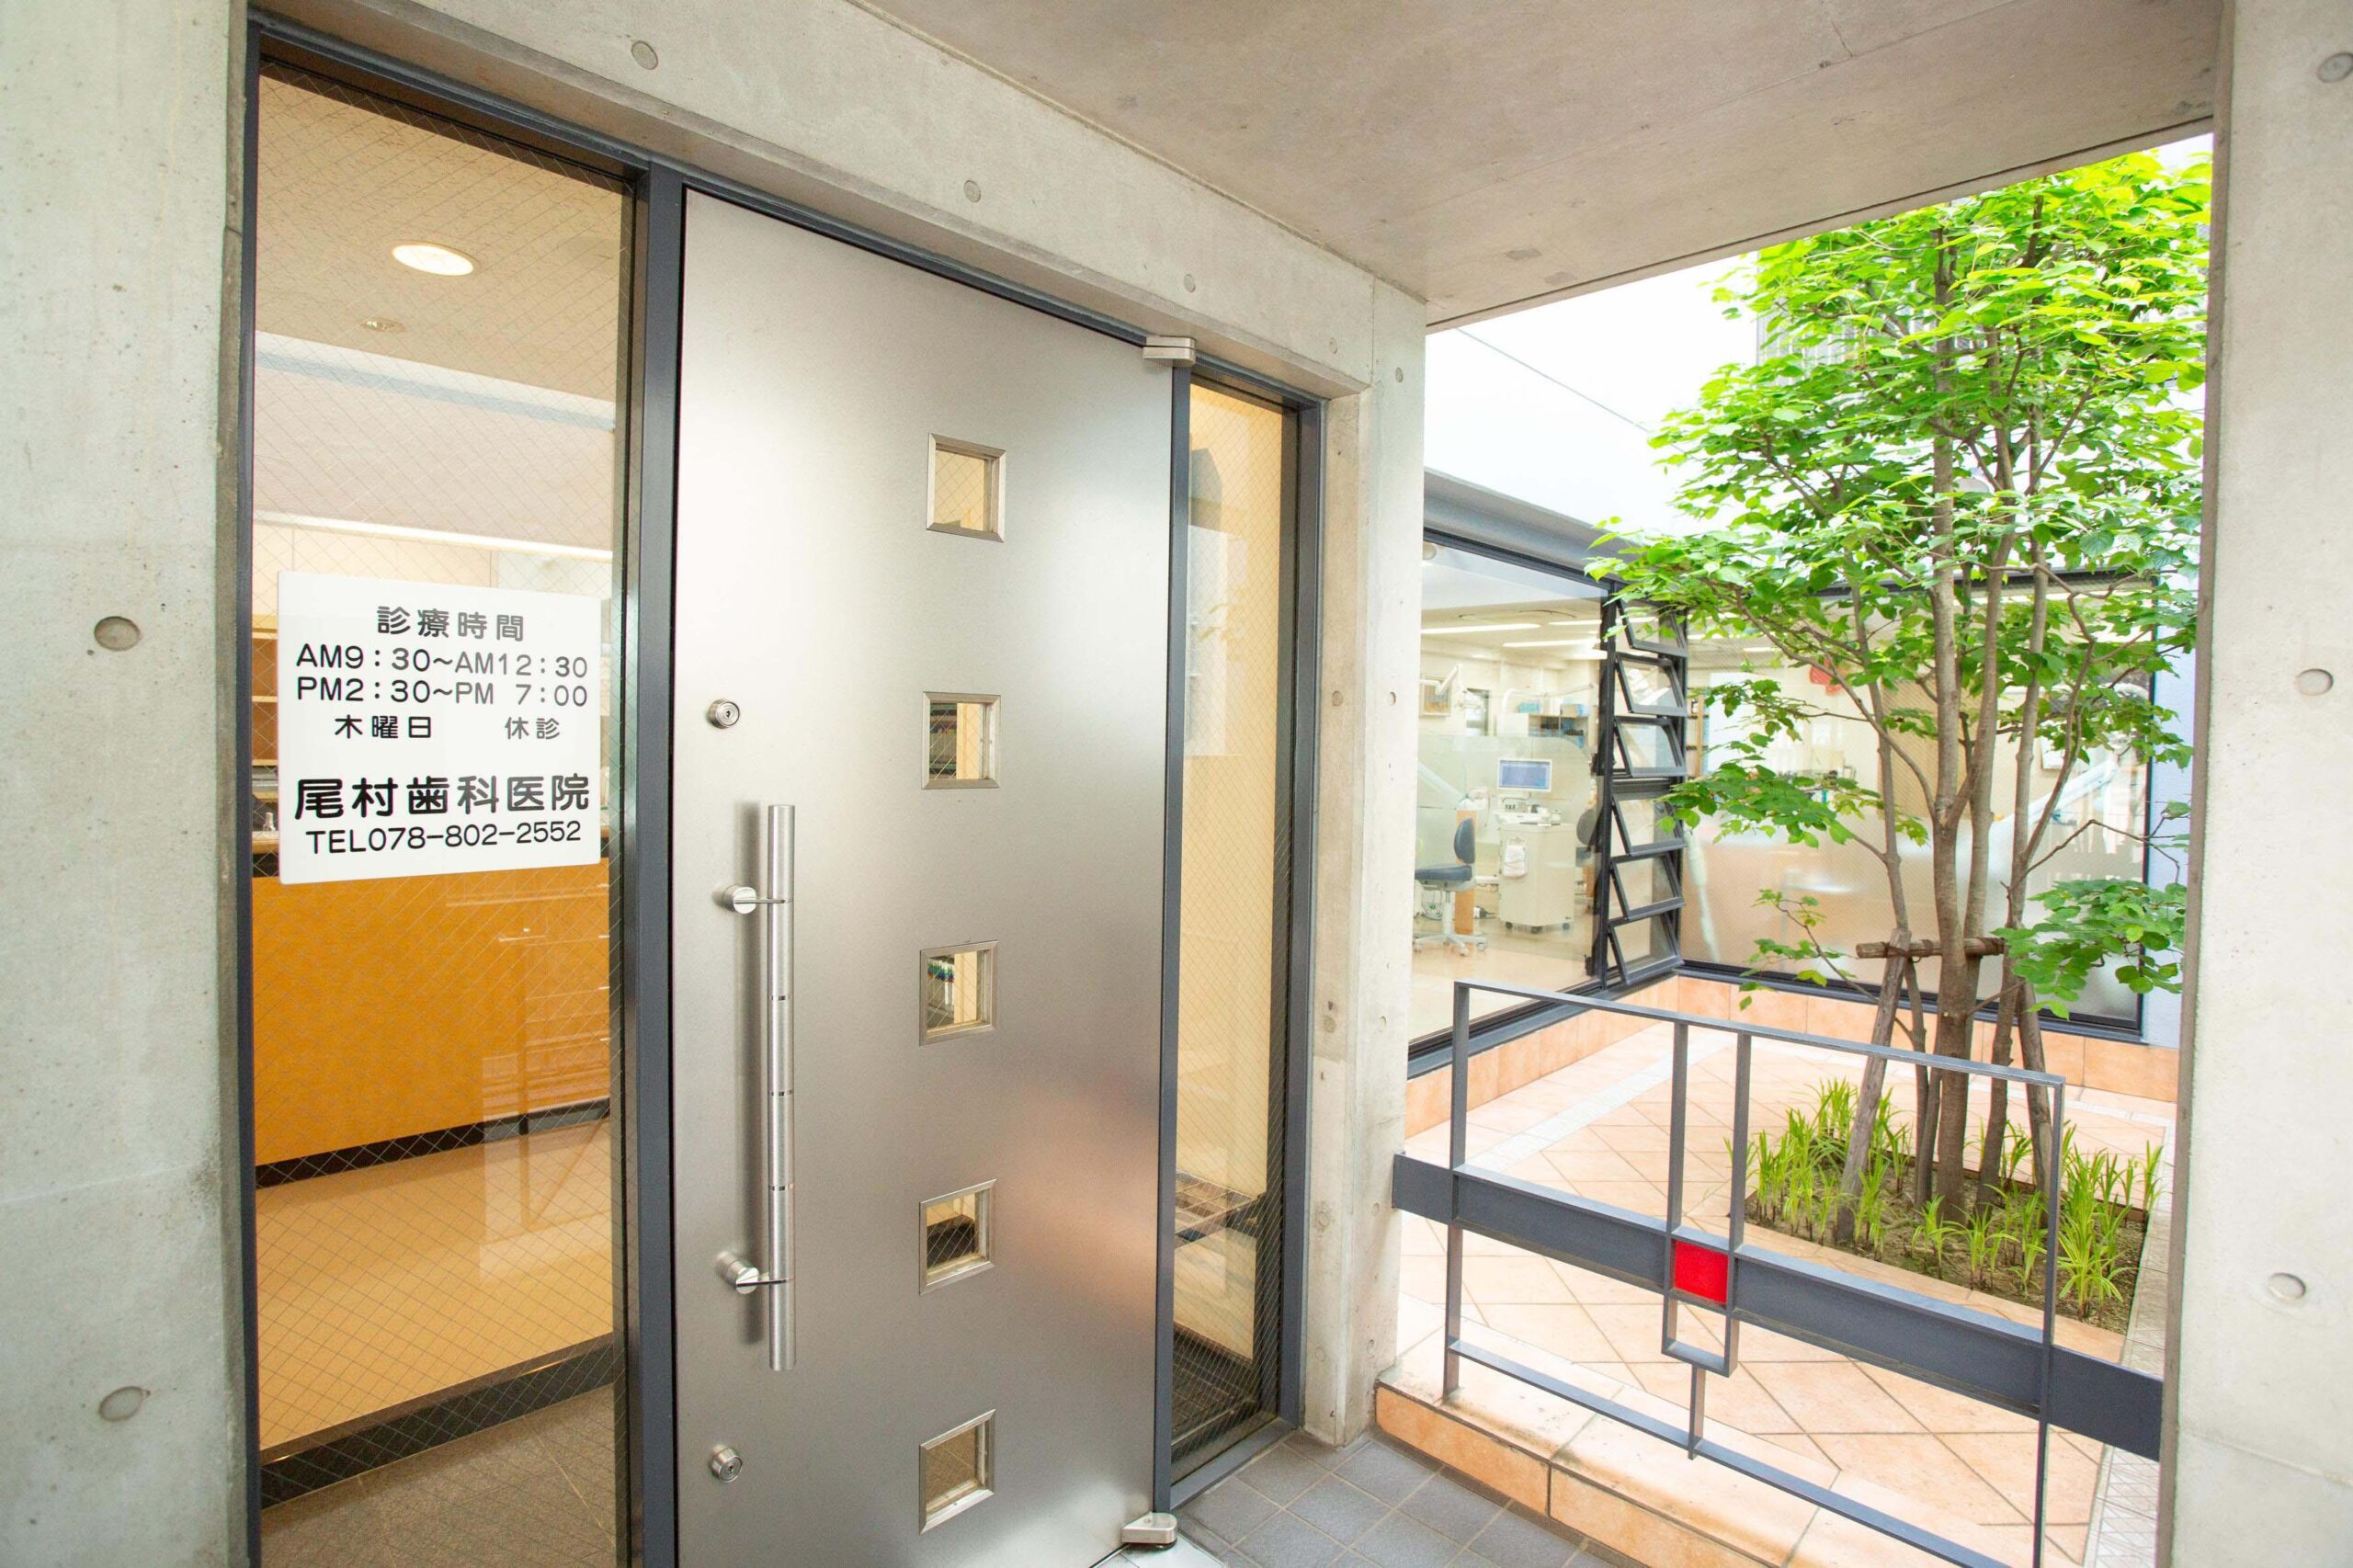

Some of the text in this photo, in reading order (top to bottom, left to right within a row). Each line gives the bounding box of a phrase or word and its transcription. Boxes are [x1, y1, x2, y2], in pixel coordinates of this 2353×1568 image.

[376, 606, 524, 642] 診療時間
[334, 714, 561, 740] 木曜日 休診
[294, 773, 590, 821] 尾村歯科医院
[305, 821, 582, 855] TEL078-802-2552
